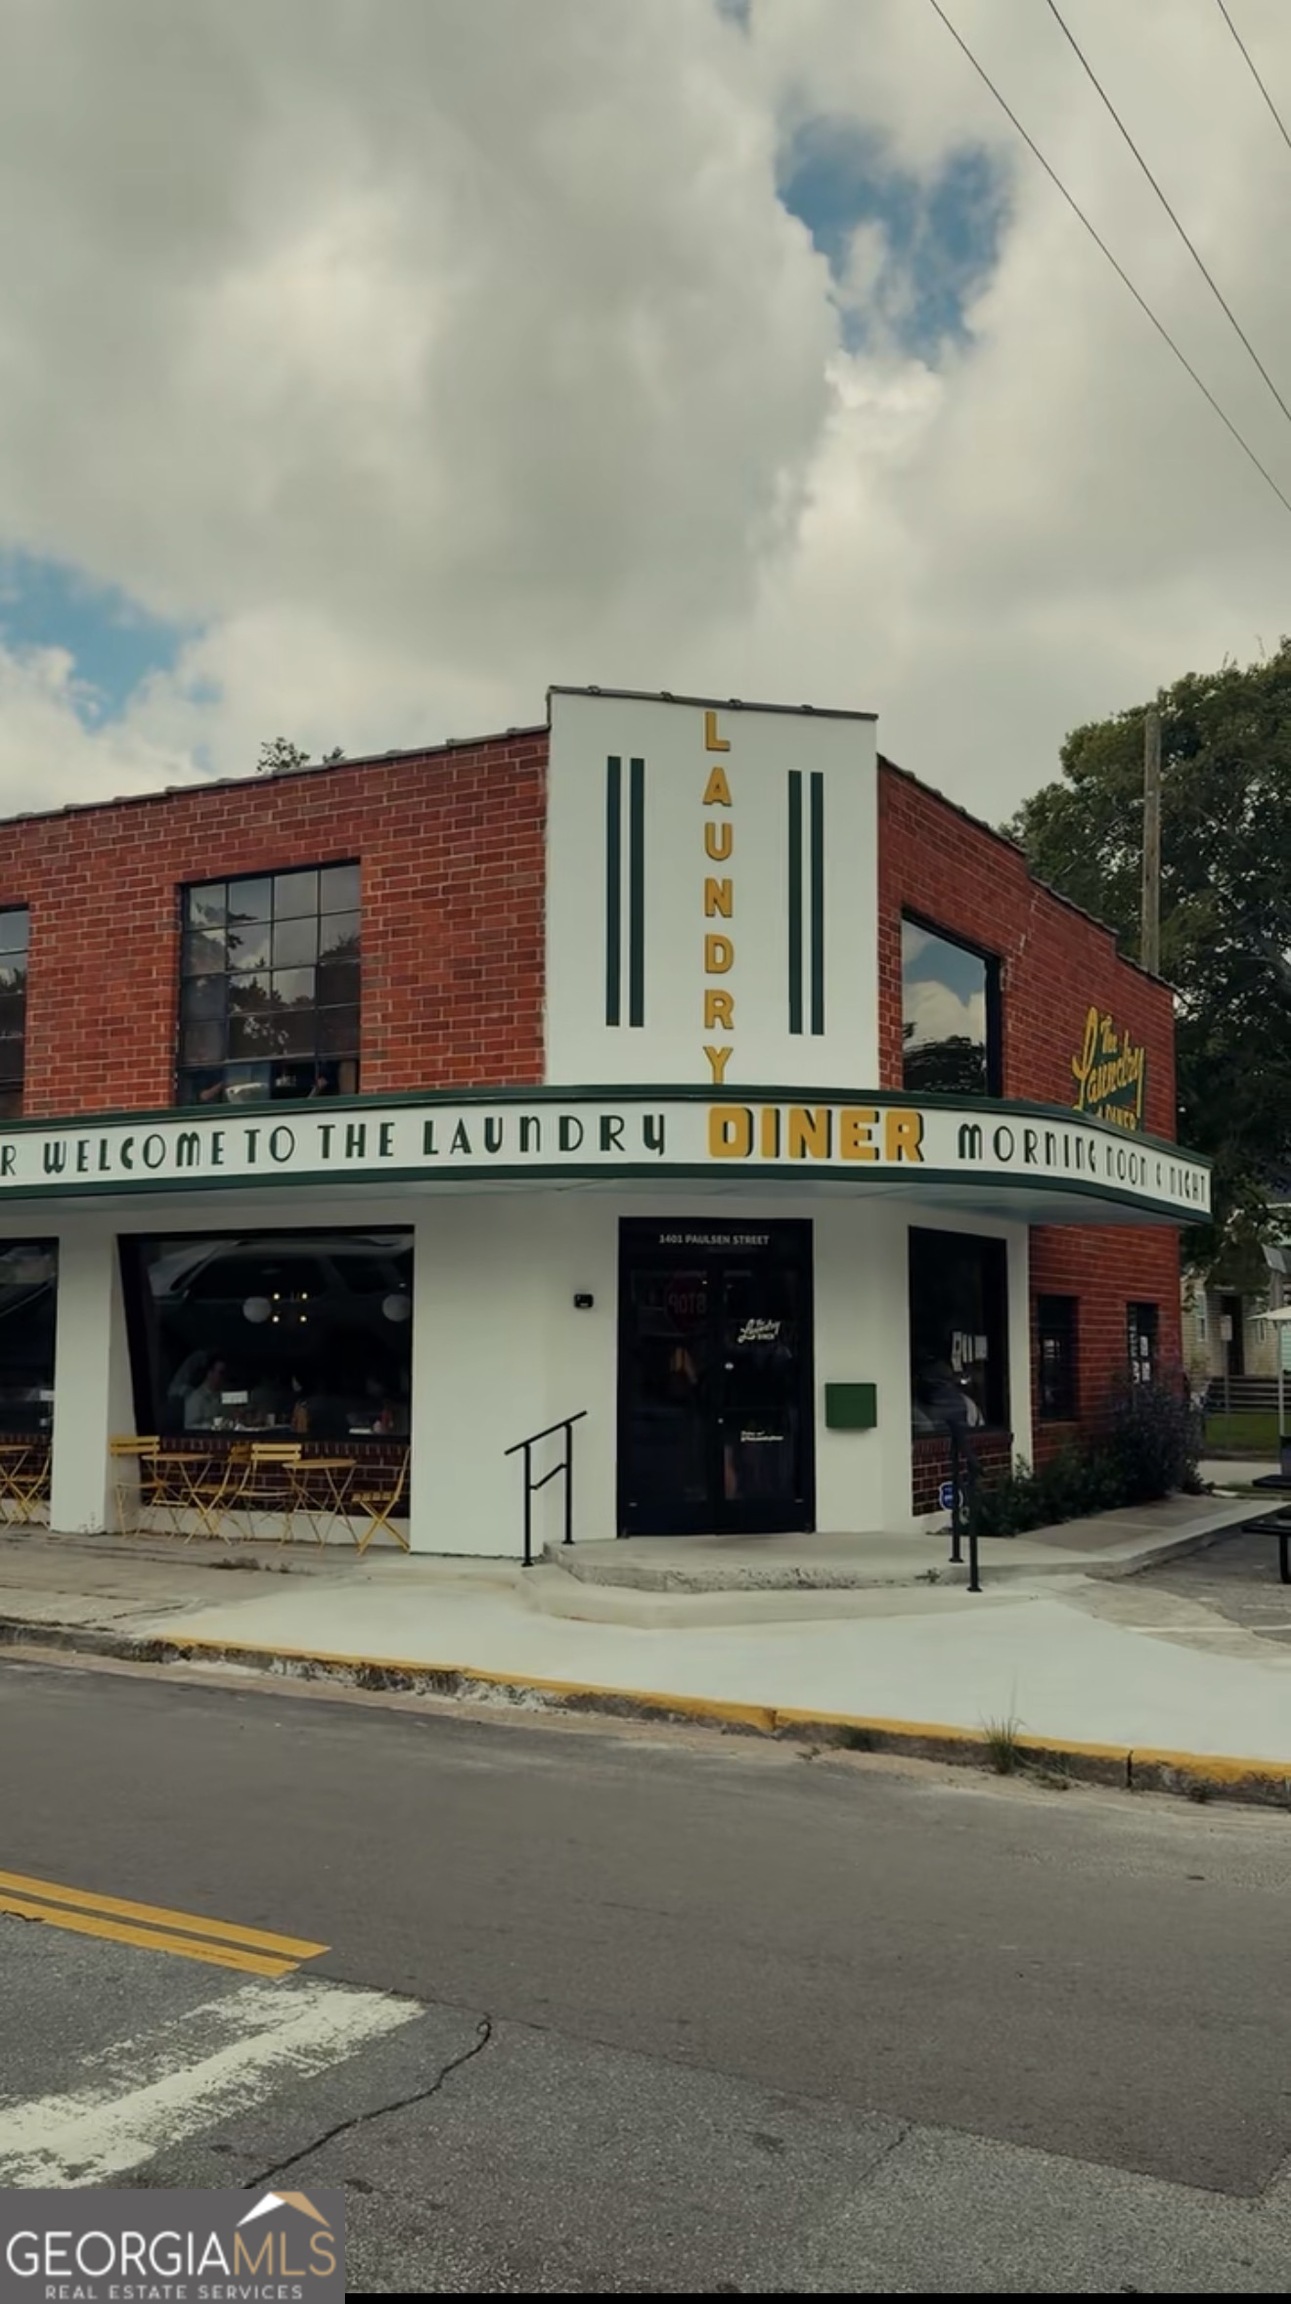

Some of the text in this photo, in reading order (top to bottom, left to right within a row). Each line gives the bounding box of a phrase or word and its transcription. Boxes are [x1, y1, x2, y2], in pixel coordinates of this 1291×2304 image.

[702, 711, 735, 1086] LAUNDRY
[43, 1131, 225, 1174] WELCOME
[244, 1125, 295, 1163] TO
[317, 1122, 395, 1159] THE
[423, 1114, 664, 1156] LAUNDRY
[709, 1106, 924, 1163] DINER
[957, 1123, 1096, 1172] MORNING
[1107, 1145, 1147, 1186] NOON
[1170, 1166, 1206, 1203] NIGHT
[685, 1234, 731, 1245] PAULSEN
[733, 1235, 769, 1245] STREET
